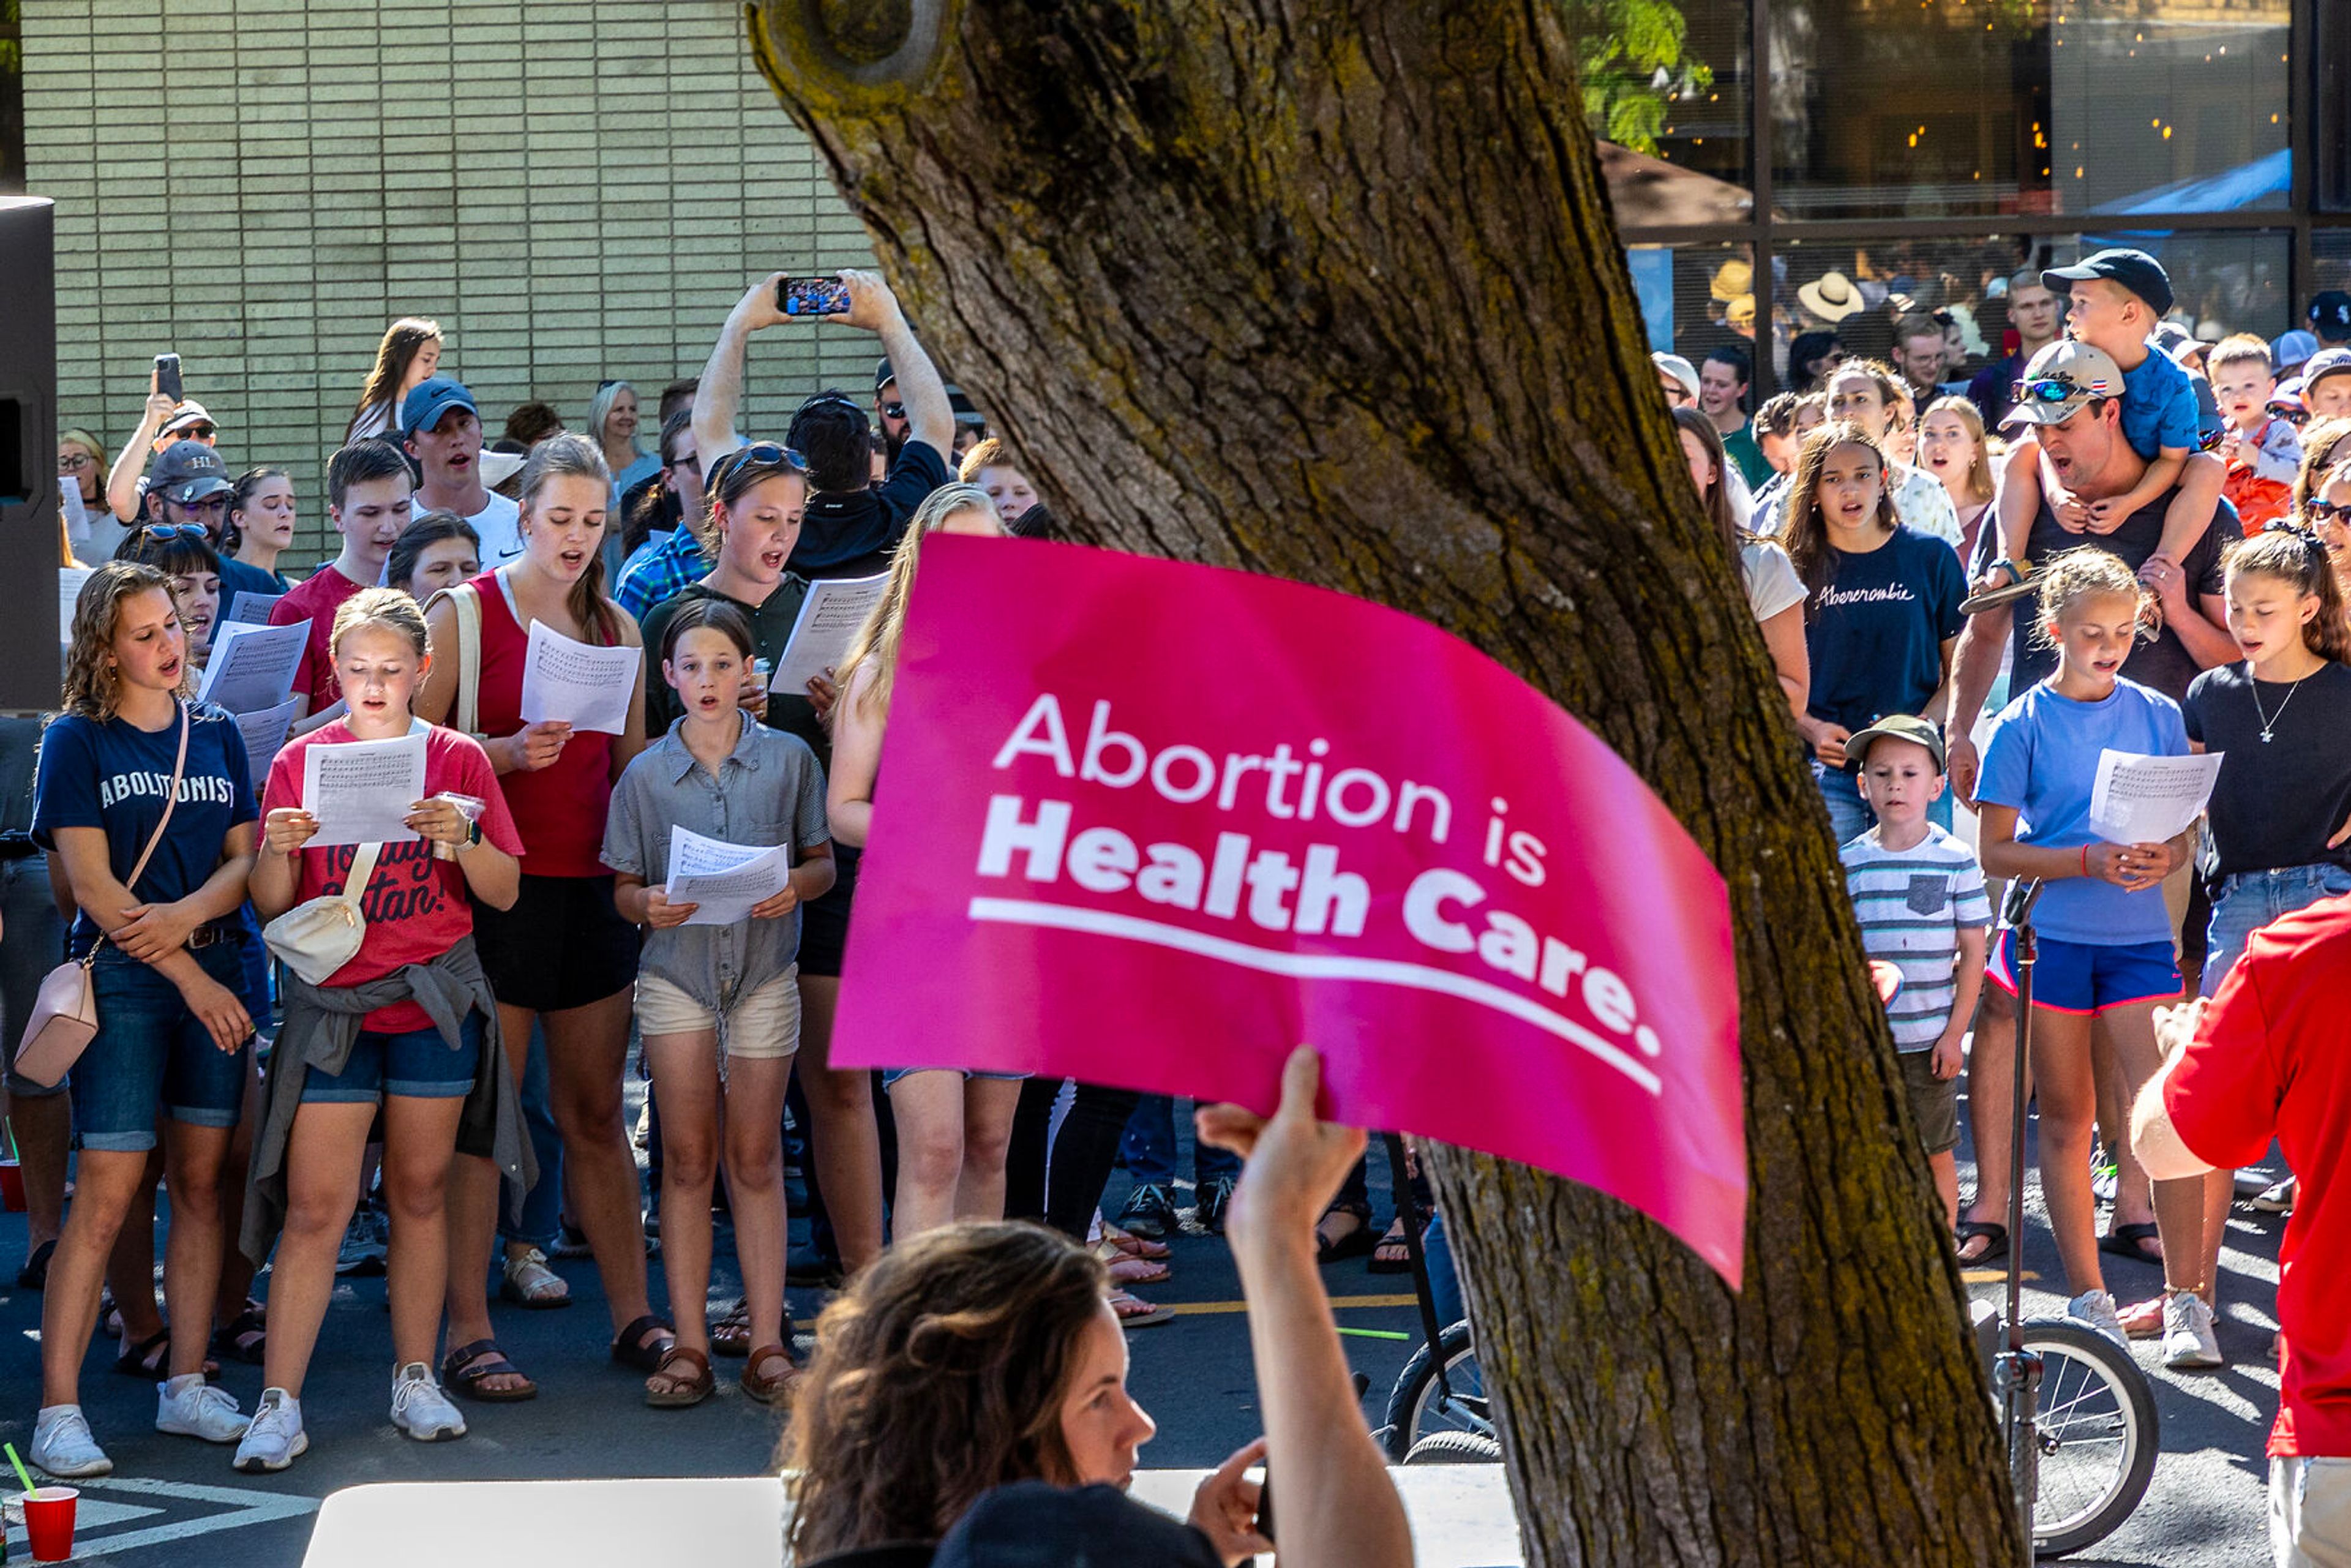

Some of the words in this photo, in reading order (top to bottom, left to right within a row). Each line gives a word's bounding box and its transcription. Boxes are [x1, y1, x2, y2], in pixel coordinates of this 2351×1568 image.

[1814, 581, 1916, 611] Abercrombie
[100, 771, 234, 809] ABOLITONIST
[992, 694, 1451, 842] Abortion
[1485, 798, 1546, 885] is
[976, 795, 1370, 936] Health
[1403, 869, 1662, 1057] Care.
